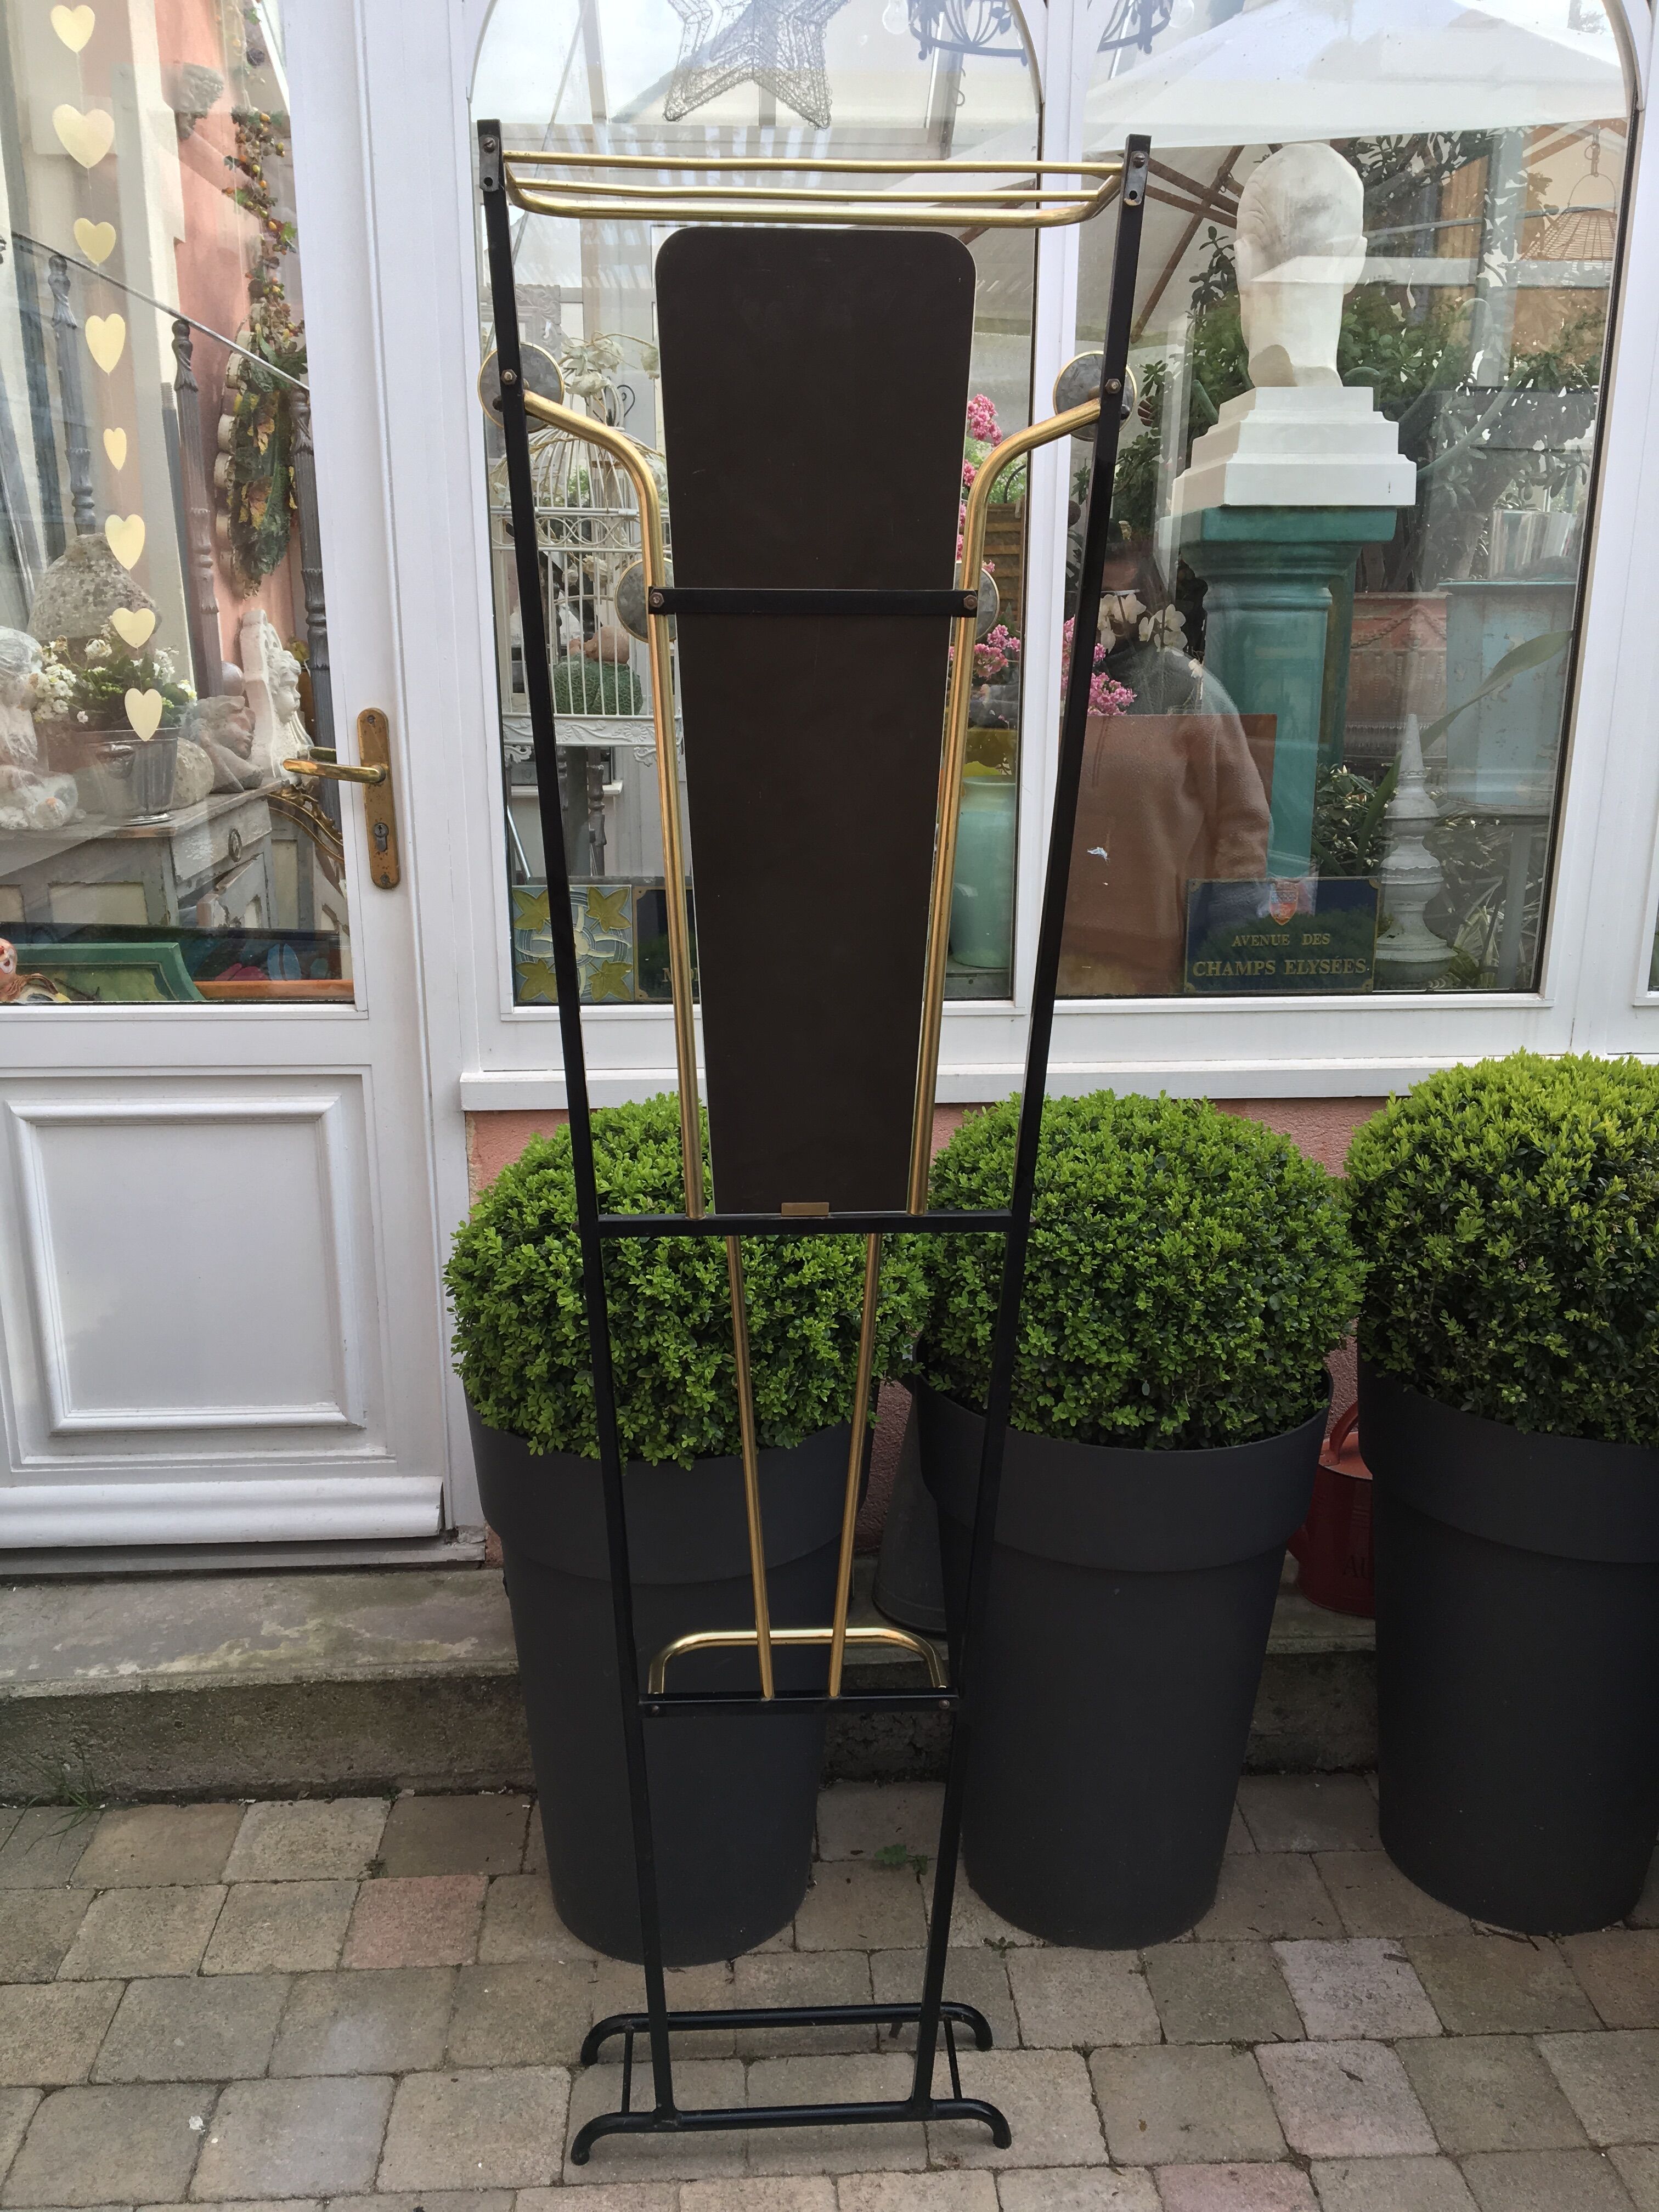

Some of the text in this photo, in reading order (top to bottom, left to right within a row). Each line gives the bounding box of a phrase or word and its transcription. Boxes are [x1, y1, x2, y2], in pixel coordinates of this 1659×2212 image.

[1232, 933, 1331, 947] AVENUE DES
[1192, 960, 1276, 977] CHAMPS
